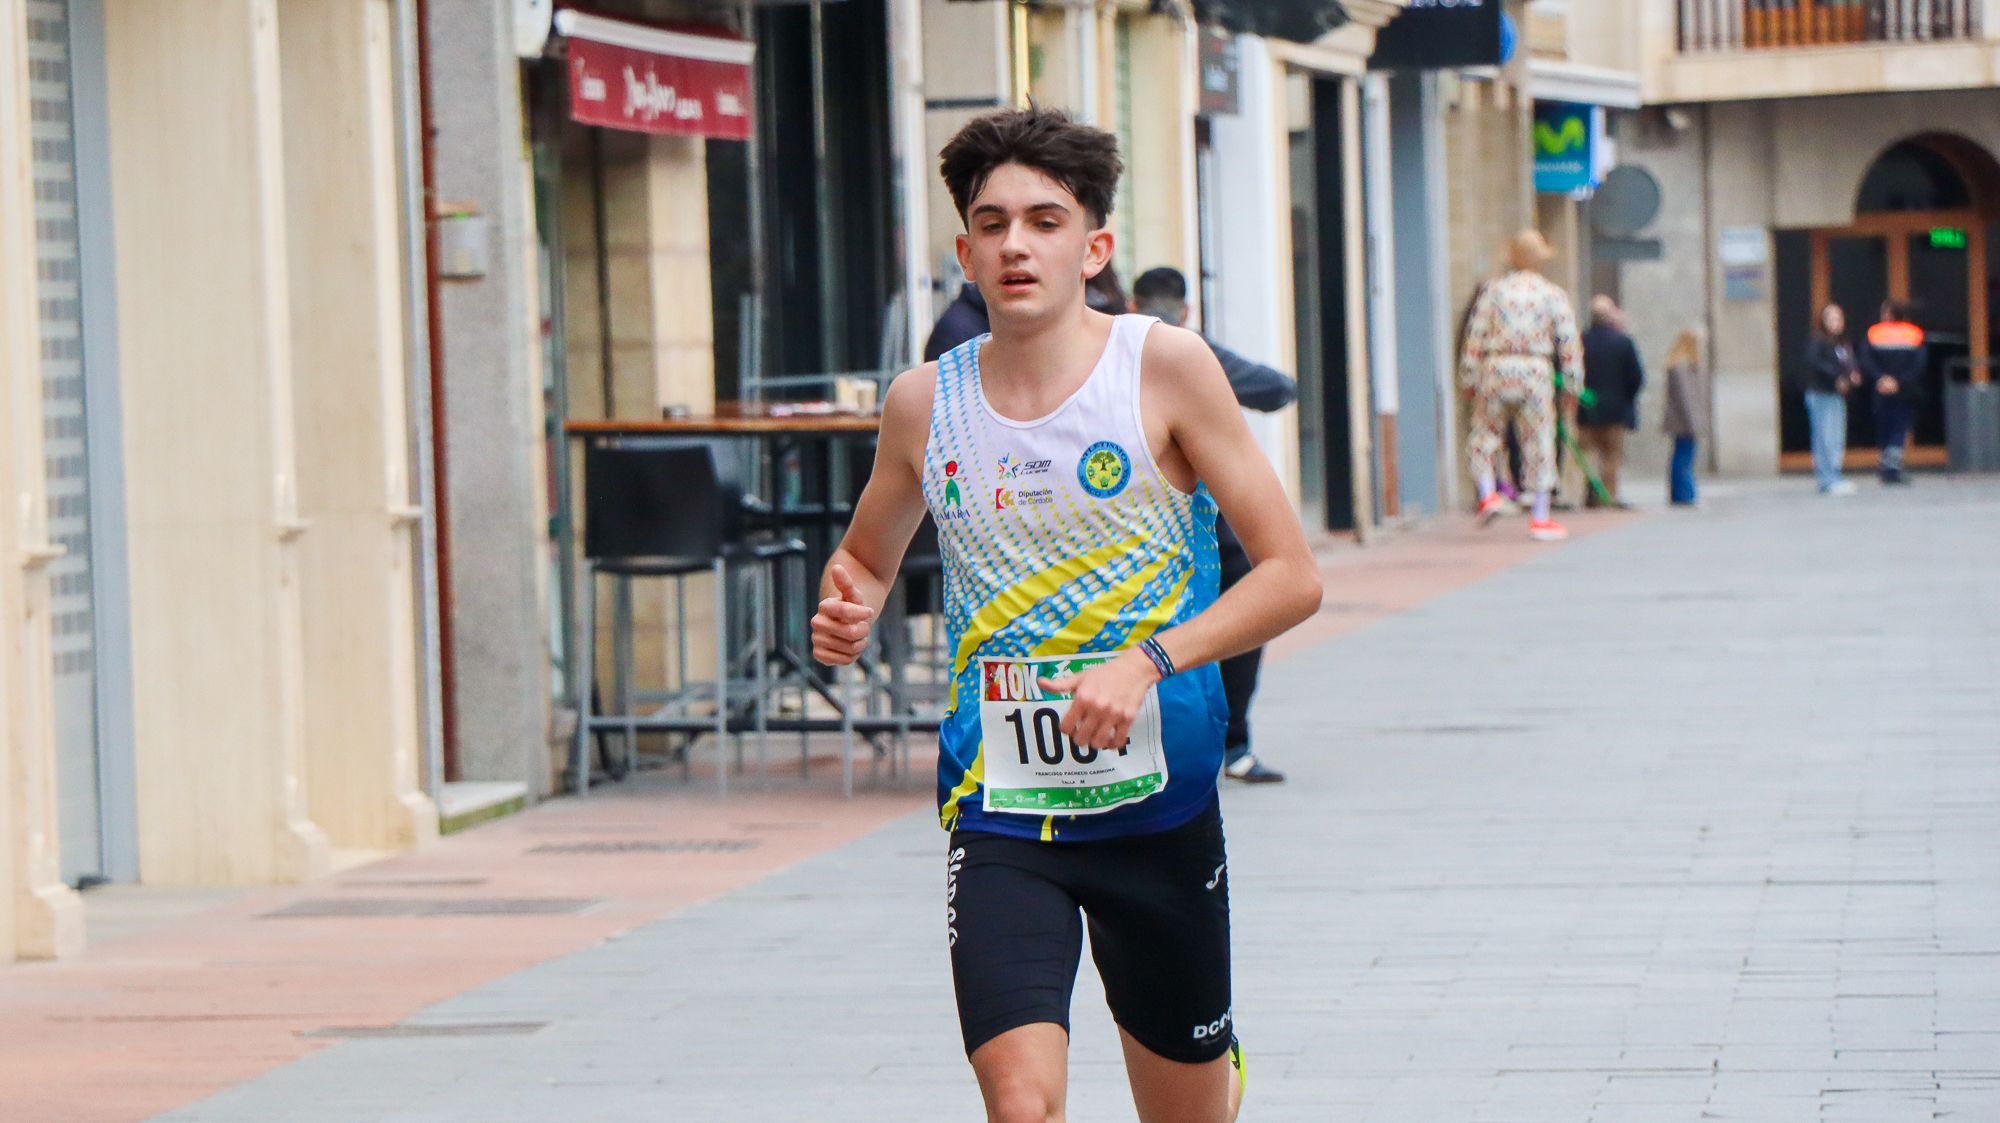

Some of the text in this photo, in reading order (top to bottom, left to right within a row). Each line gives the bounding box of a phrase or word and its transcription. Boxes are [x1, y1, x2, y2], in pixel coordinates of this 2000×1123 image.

[1017, 498, 1027, 506] de
[1018, 487, 1053, 499] Diputación
[994, 663, 1044, 701] 10K
[1004, 707, 1132, 766] 10
[1193, 1005, 1232, 1039] DC
